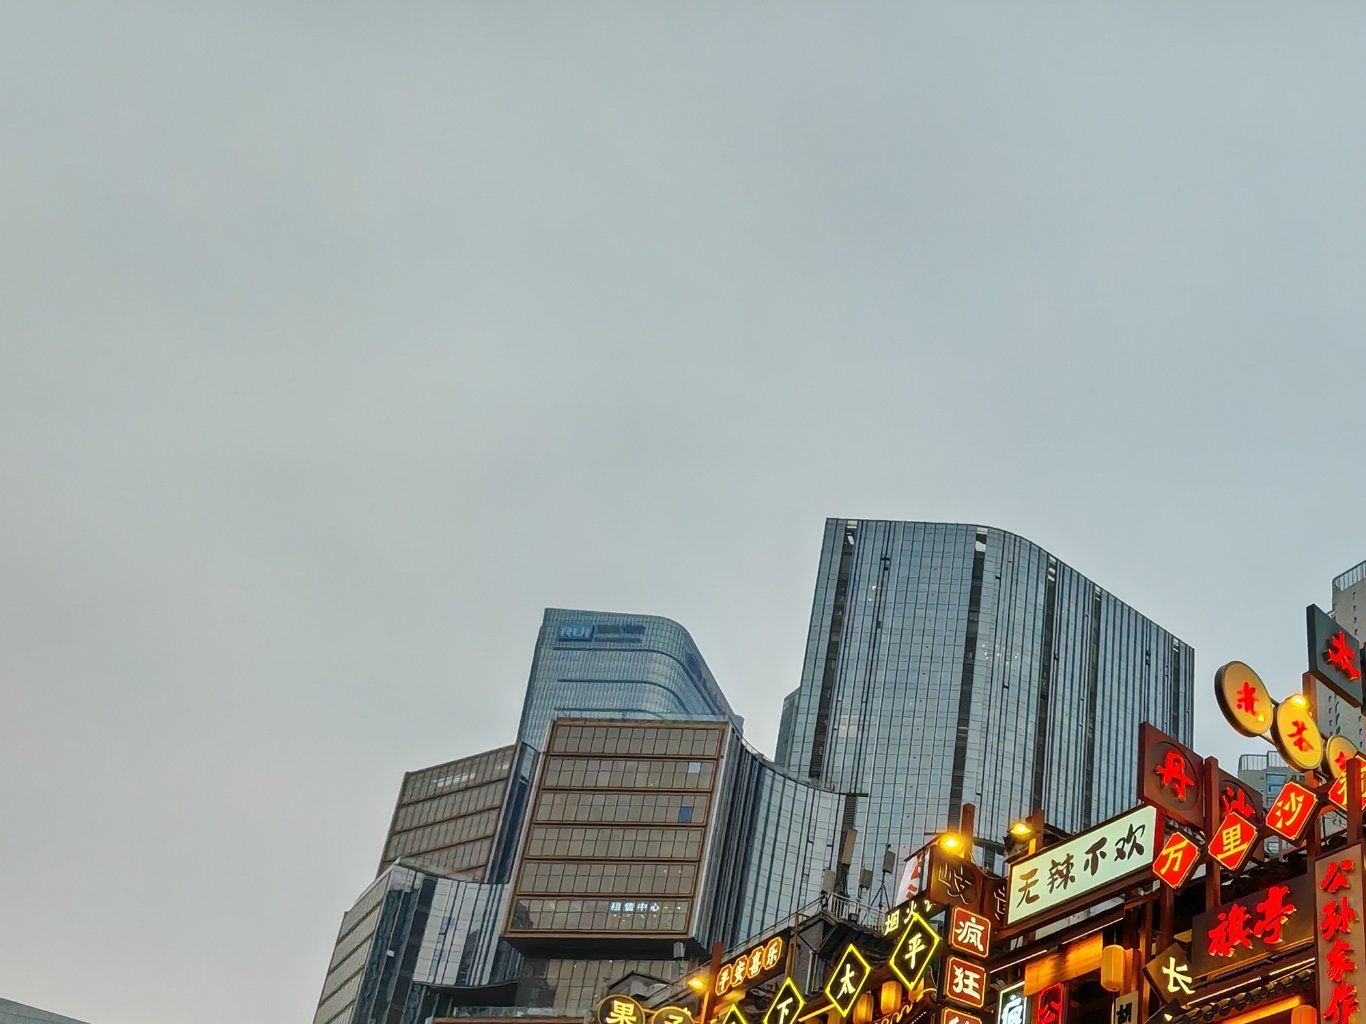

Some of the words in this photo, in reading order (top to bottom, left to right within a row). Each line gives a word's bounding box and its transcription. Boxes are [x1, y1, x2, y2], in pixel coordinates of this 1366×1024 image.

[1016, 823, 1147, 909] 无辣不欢
[1207, 886, 1297, 958] 旗亭
[718, 938, 780, 992] 平安喜乐
